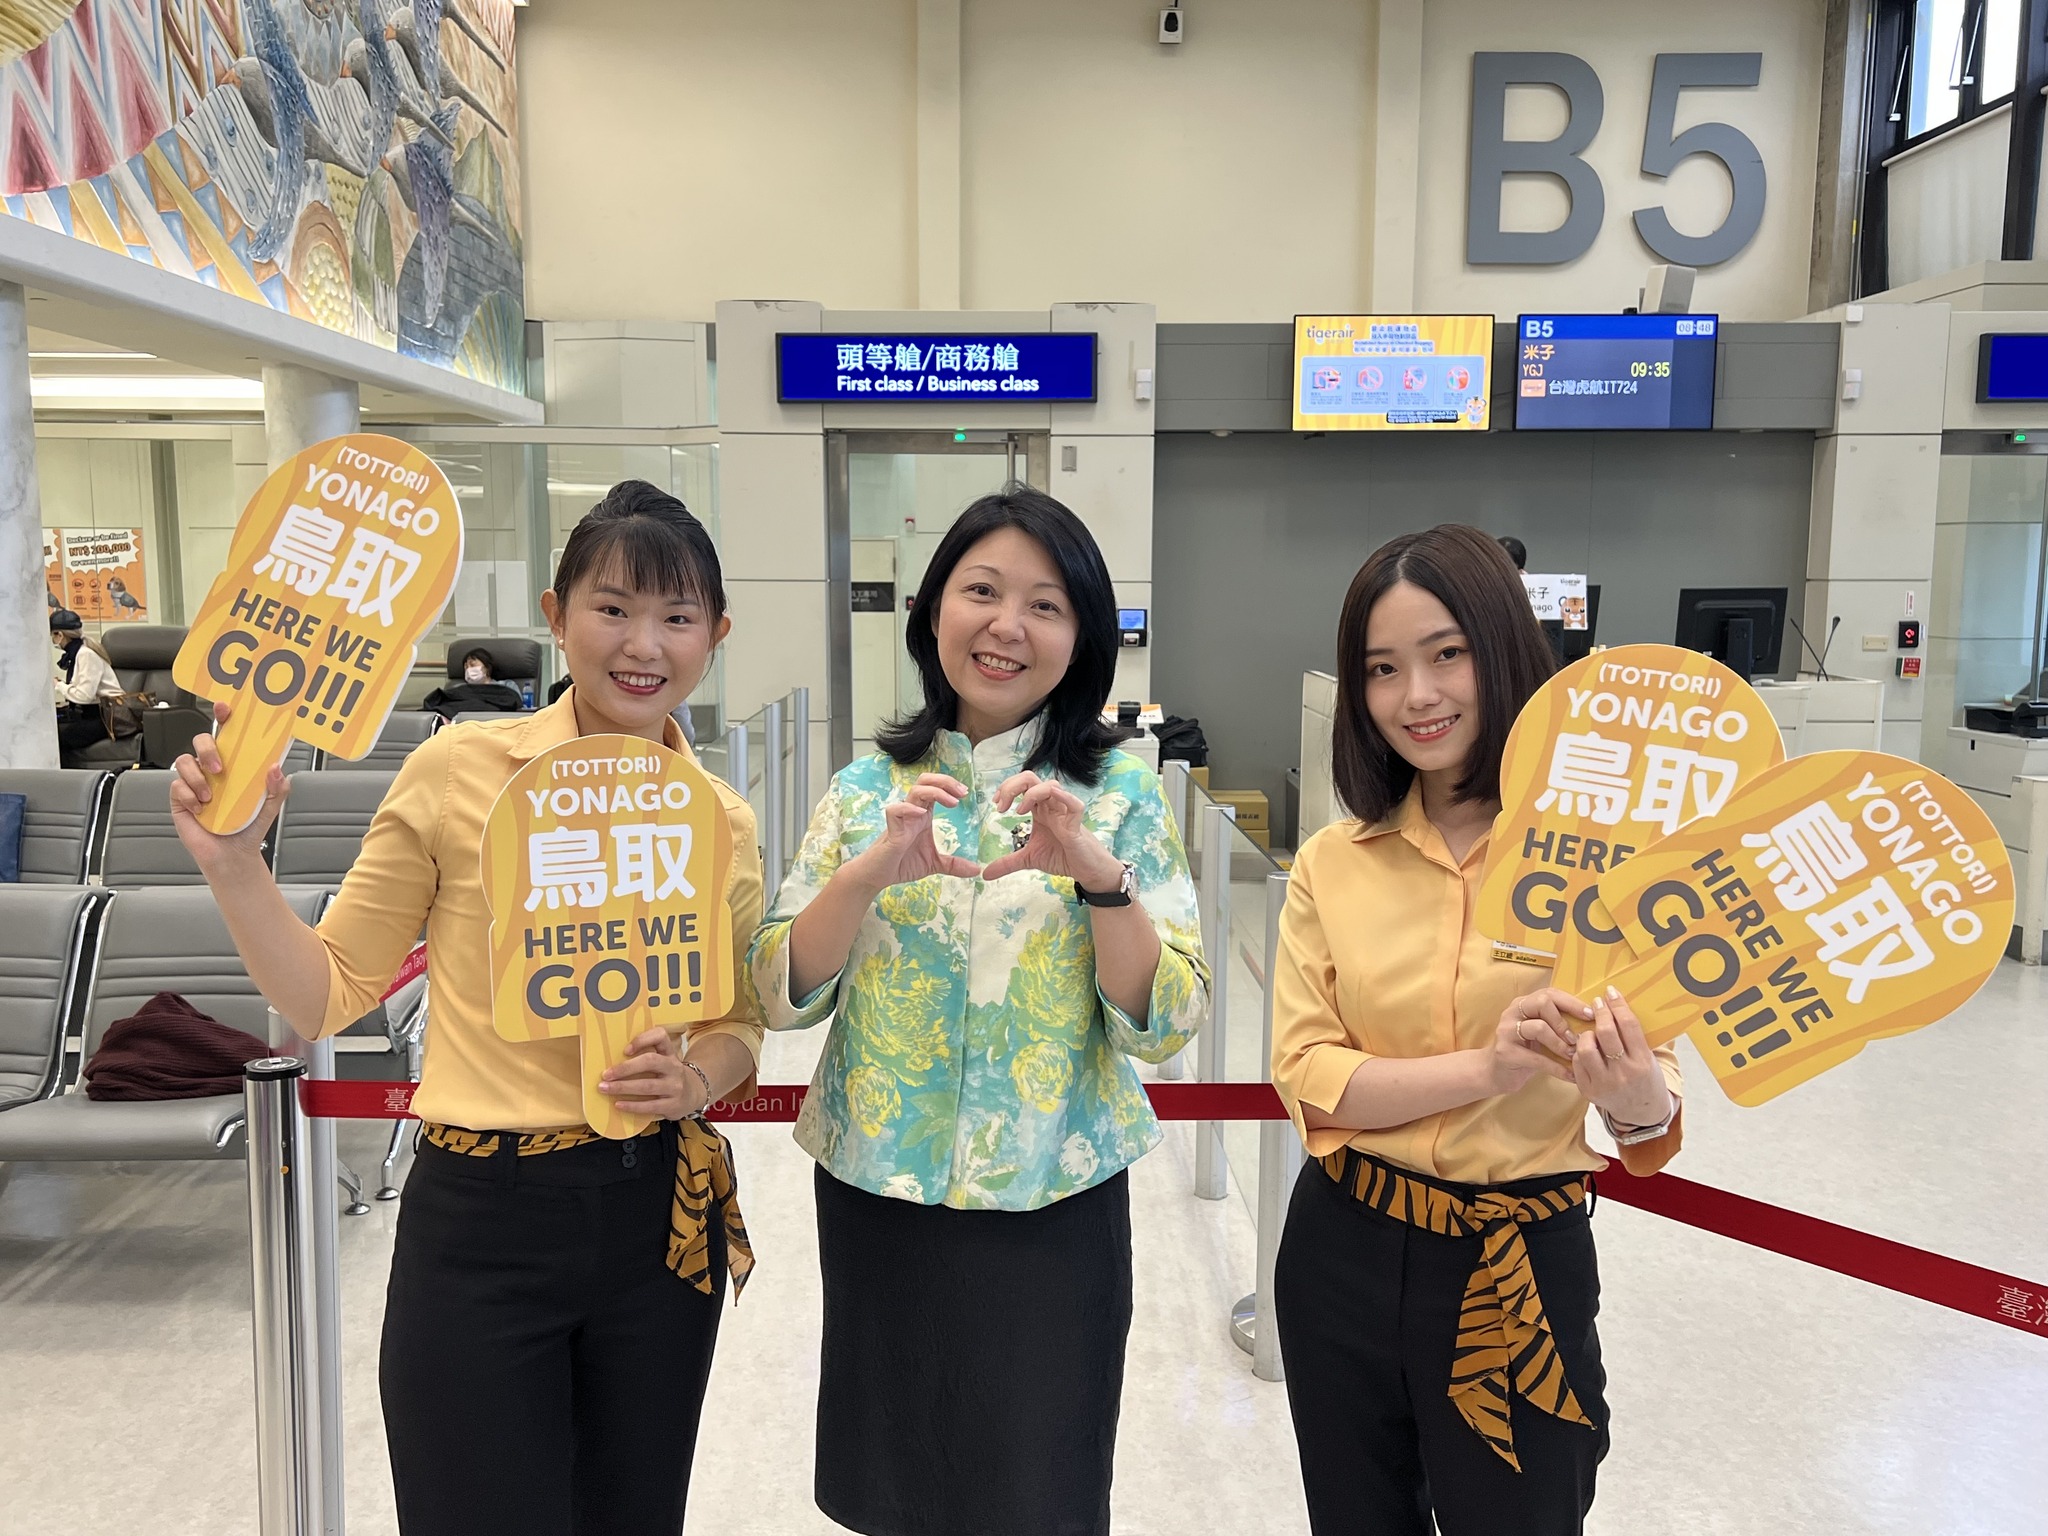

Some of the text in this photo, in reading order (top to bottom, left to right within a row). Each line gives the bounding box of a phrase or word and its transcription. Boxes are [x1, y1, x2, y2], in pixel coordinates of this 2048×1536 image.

[1467, 51, 1767, 267] B5
[836, 342, 1020, 373] 頭等艙/商務艙
[1523, 344, 1555, 360] 米子
[1525, 320, 1554, 338] B5
[837, 375, 1039, 392] First class / Business class
[1522, 361, 1671, 378] YGJ 09:35
[1548, 380, 1638, 395] 台灣虎航IT724
[337, 445, 430, 492] (TOTTORI)
[303, 464, 440, 537] YONAGO
[253, 504, 422, 627] 鳥取
[230, 588, 382, 672] HERE WE
[207, 630, 365, 734] GO!!!
[1599, 662, 1722, 697] (TOTTORI)
[1567, 687, 1748, 743] YONAGO
[551, 755, 661, 779] (TOTTORI)
[1534, 731, 1739, 837] 鳥取
[525, 781, 691, 818] YONAGO
[523, 822, 697, 914] 鳥取
[1845, 771, 1983, 945] YONAGO
[1900, 780, 1998, 895] (TOTTORI)
[1741, 799, 1935, 1004] 鳥取
[524, 914, 699, 959] HERE WE
[1690, 847, 1834, 1034] HERE WE
[525, 952, 702, 1018] GO!!!
[1637, 879, 1792, 1069] GO!!!
[706, 1098, 782, 1117] oyuan
